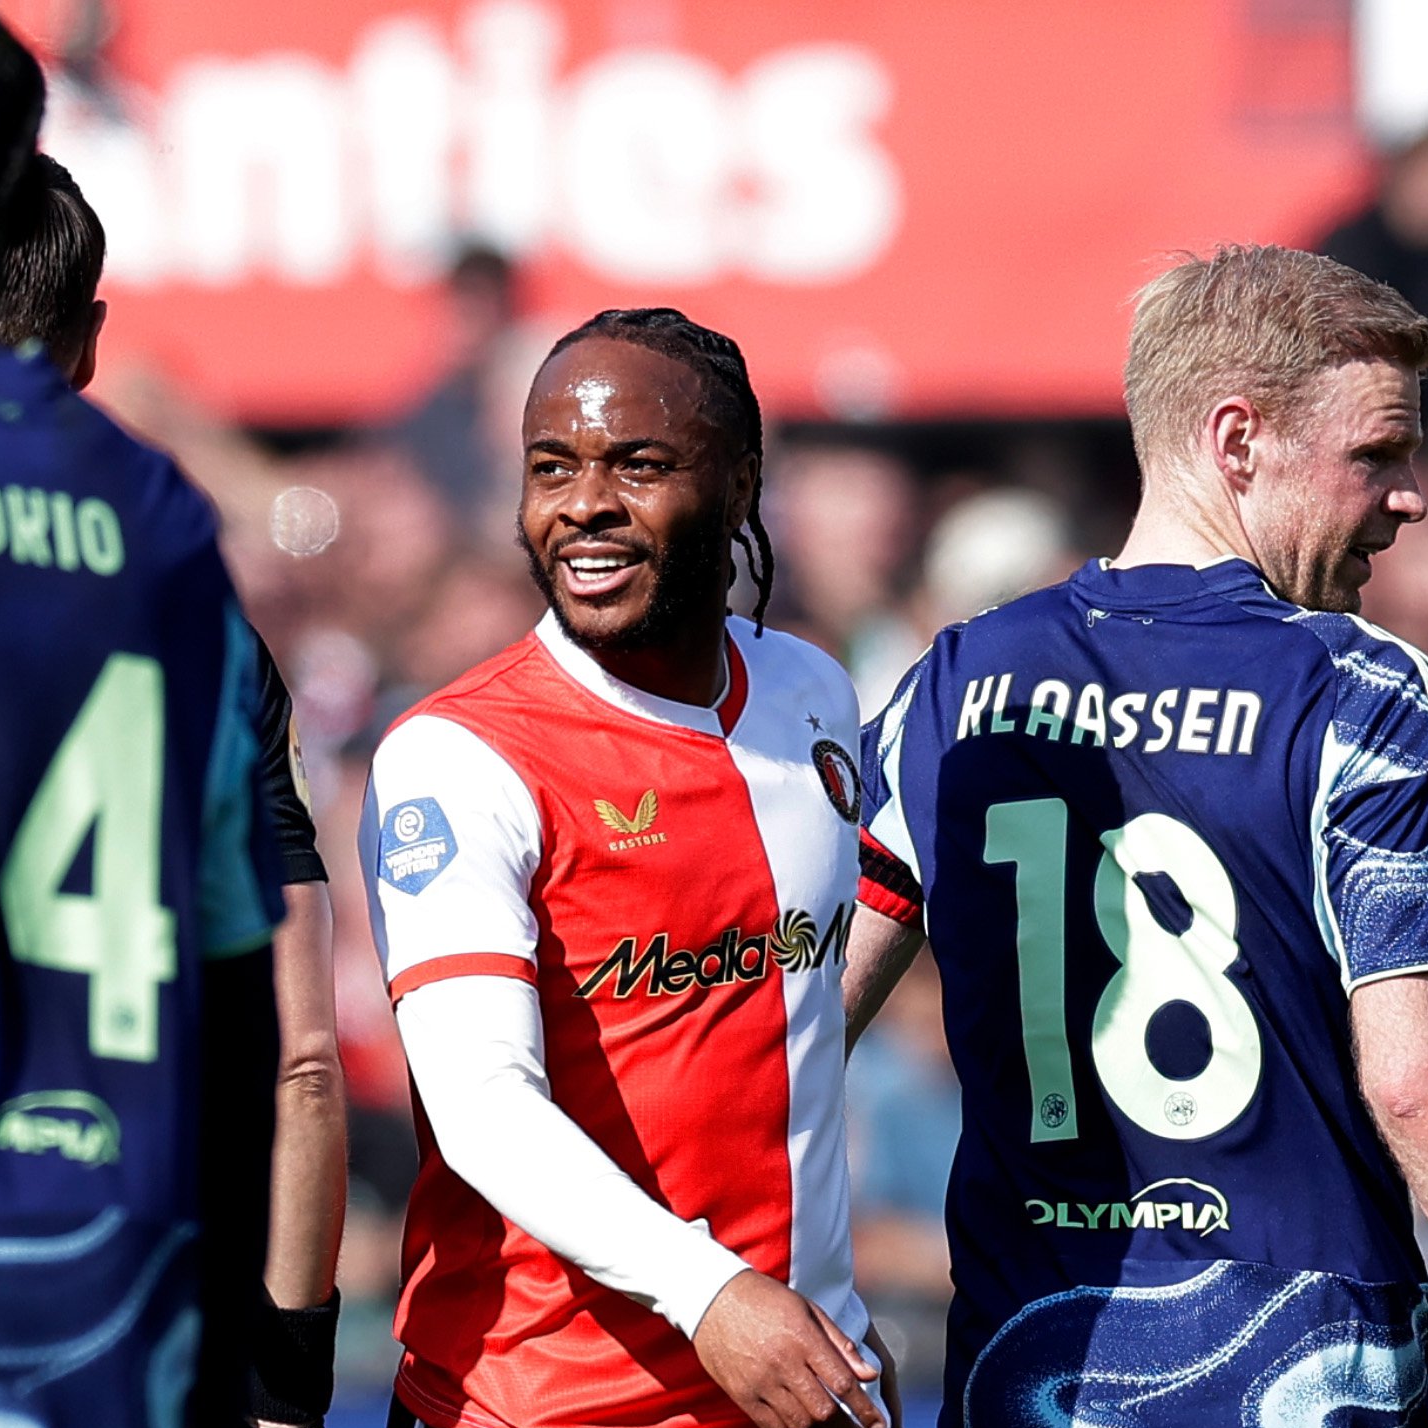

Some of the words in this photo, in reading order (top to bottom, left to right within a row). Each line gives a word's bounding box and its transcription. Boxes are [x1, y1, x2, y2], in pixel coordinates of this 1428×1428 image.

[956, 672, 1261, 756] KLAASSEN
[608, 832, 668, 852] CASTORE
[572, 927, 771, 999] Media
[982, 796, 1263, 1143] 18
[1024, 1177, 1231, 1238] OLYMPIA
